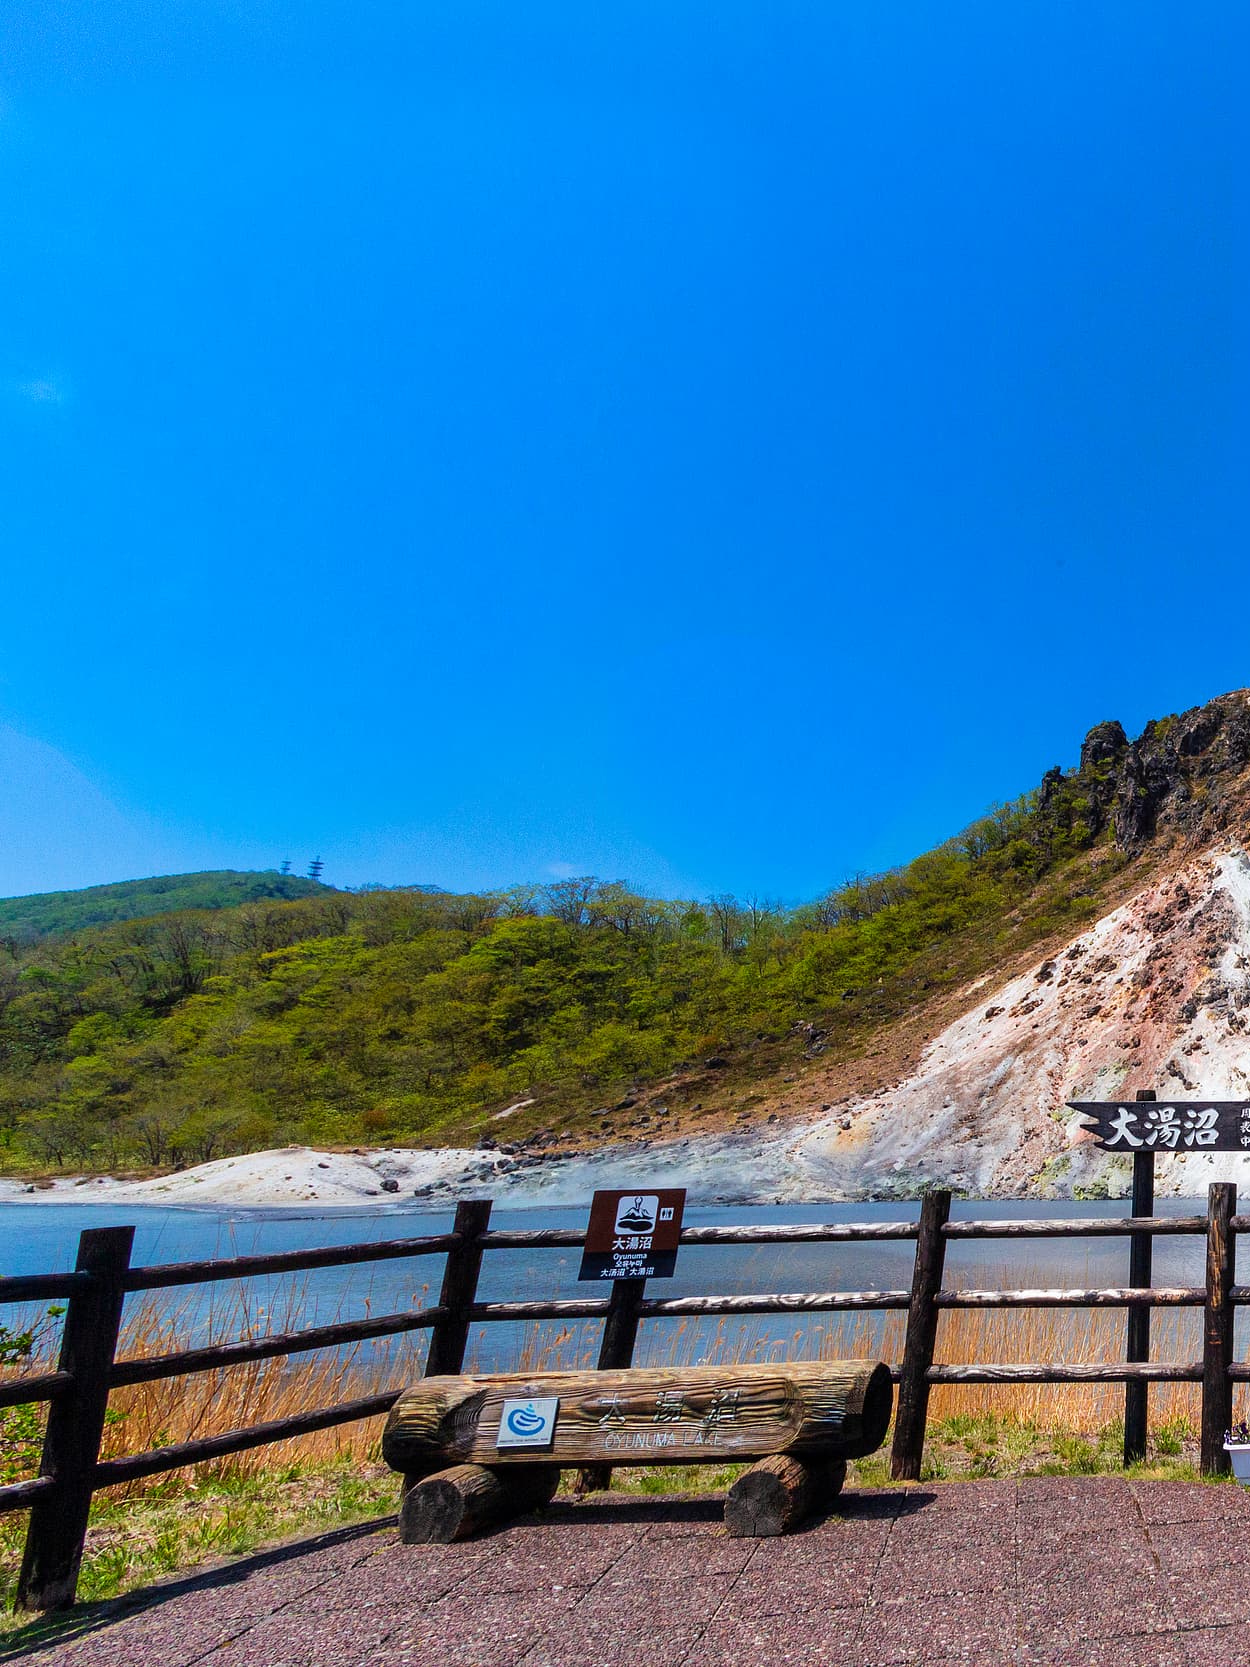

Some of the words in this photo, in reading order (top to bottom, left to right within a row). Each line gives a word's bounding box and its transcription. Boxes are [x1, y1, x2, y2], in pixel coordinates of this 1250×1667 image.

[1104, 1107, 1219, 1148] 大湯沼
[611, 1236, 653, 1250] 大湯沼
[614, 1260, 643, 1269] 오유누마
[598, 1389, 740, 1424] 大湯沼
[604, 1431, 676, 1448] OYUNUMA
